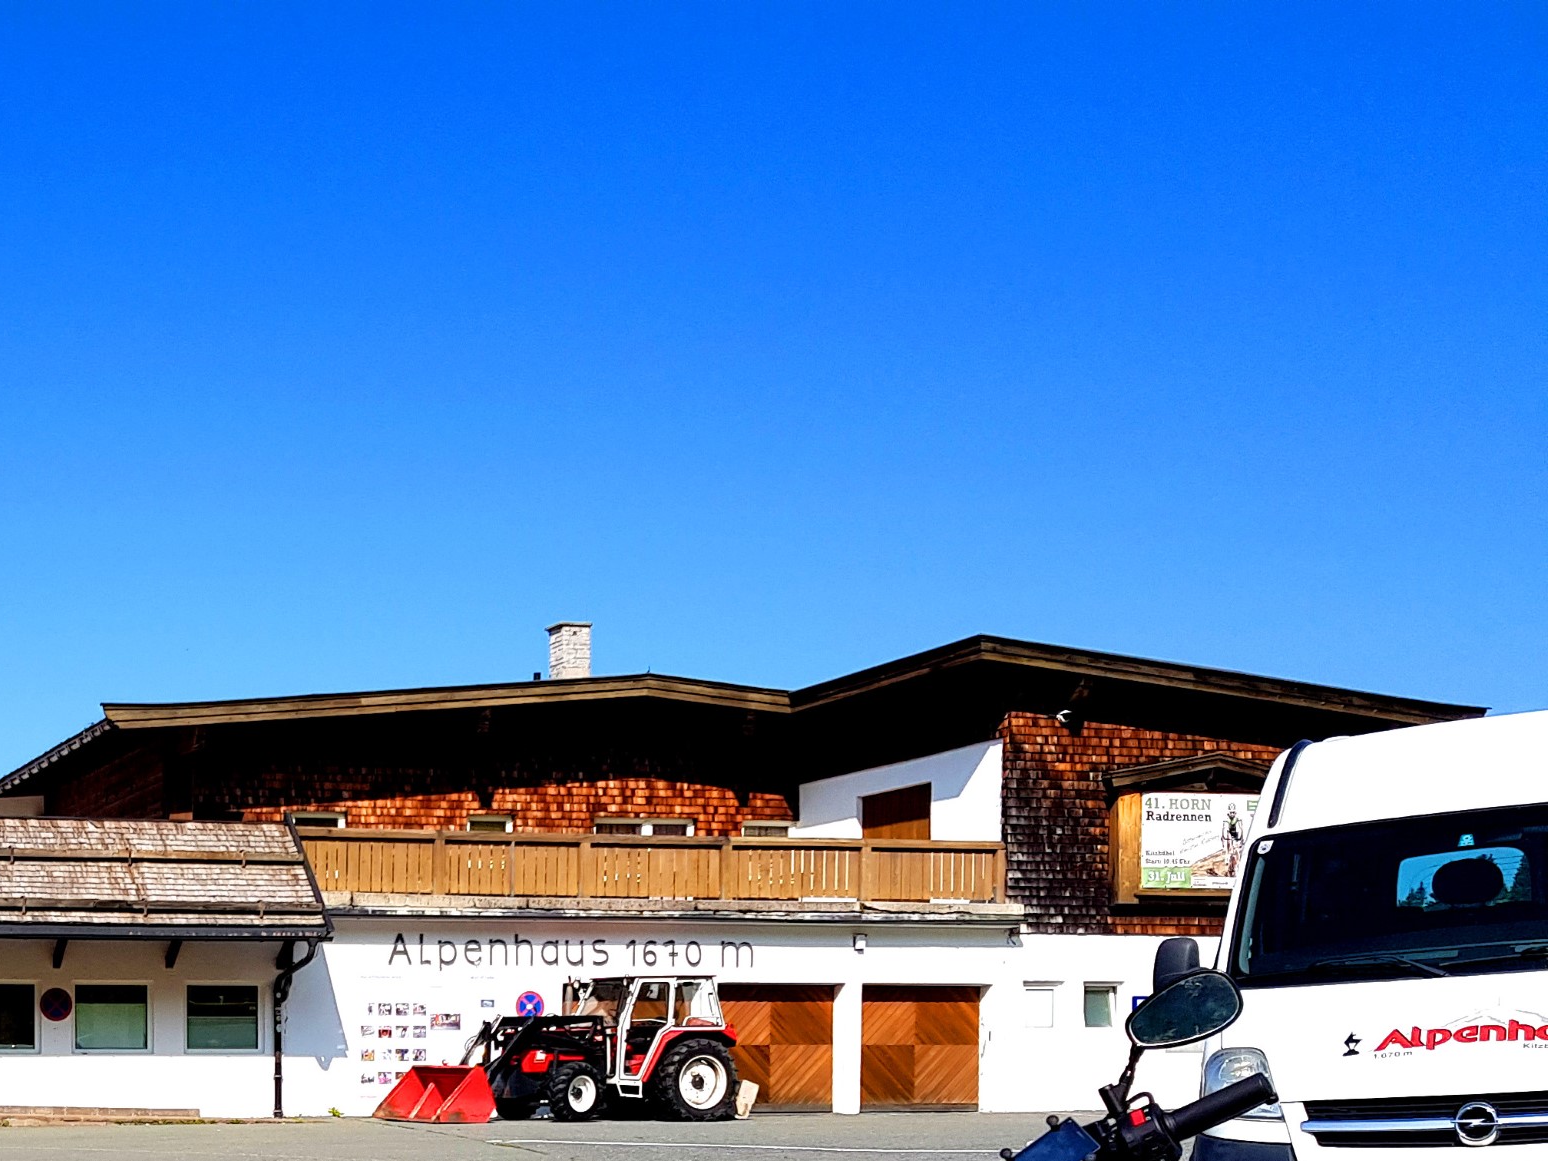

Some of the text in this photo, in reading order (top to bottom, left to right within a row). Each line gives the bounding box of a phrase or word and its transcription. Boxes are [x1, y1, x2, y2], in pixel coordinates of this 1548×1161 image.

[1145, 798, 1212, 811] 41. HORN
[1145, 811, 1213, 822] Radrennen
[1147, 871, 1165, 882] 31.
[1166, 871, 1186, 884] Juli
[387, 932, 755, 971] Alpenhaus 1670 m
